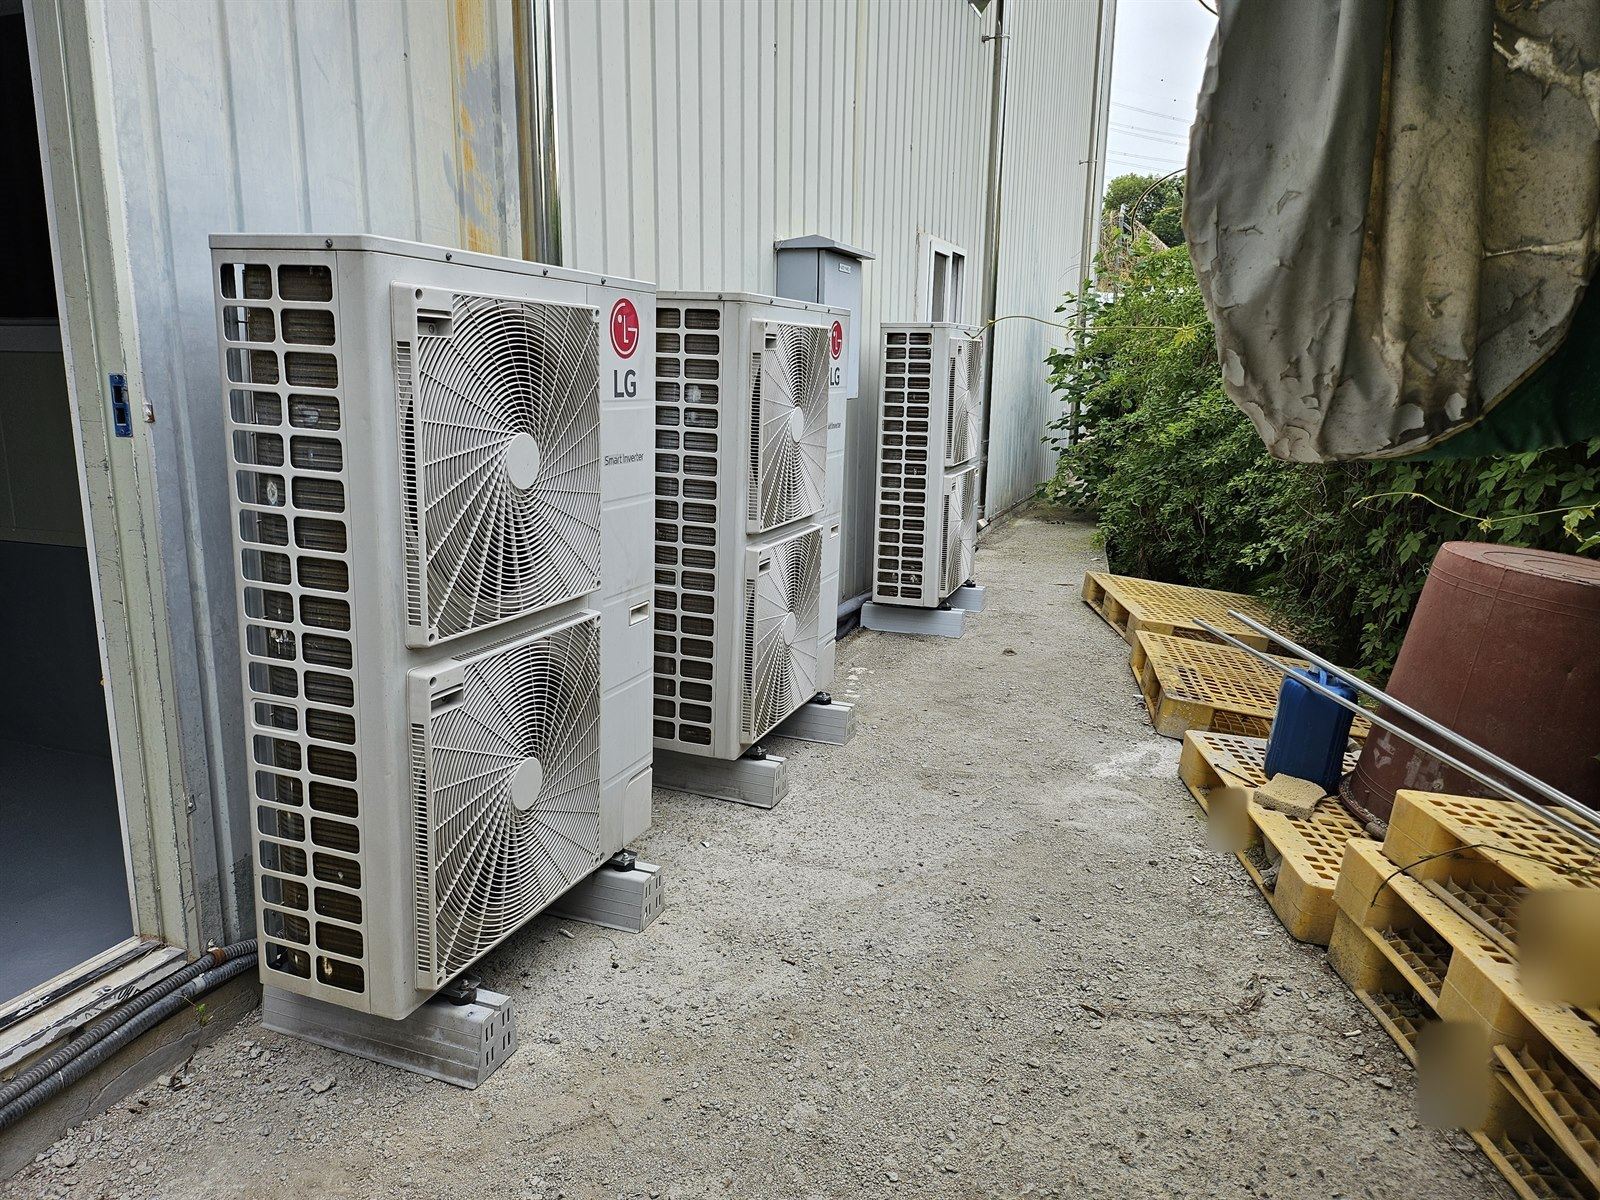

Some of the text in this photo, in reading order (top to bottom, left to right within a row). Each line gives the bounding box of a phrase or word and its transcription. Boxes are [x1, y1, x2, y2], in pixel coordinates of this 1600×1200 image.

[613, 369, 637, 398] LG
[829, 366, 840, 386] LG
[604, 454, 623, 466] Smart
